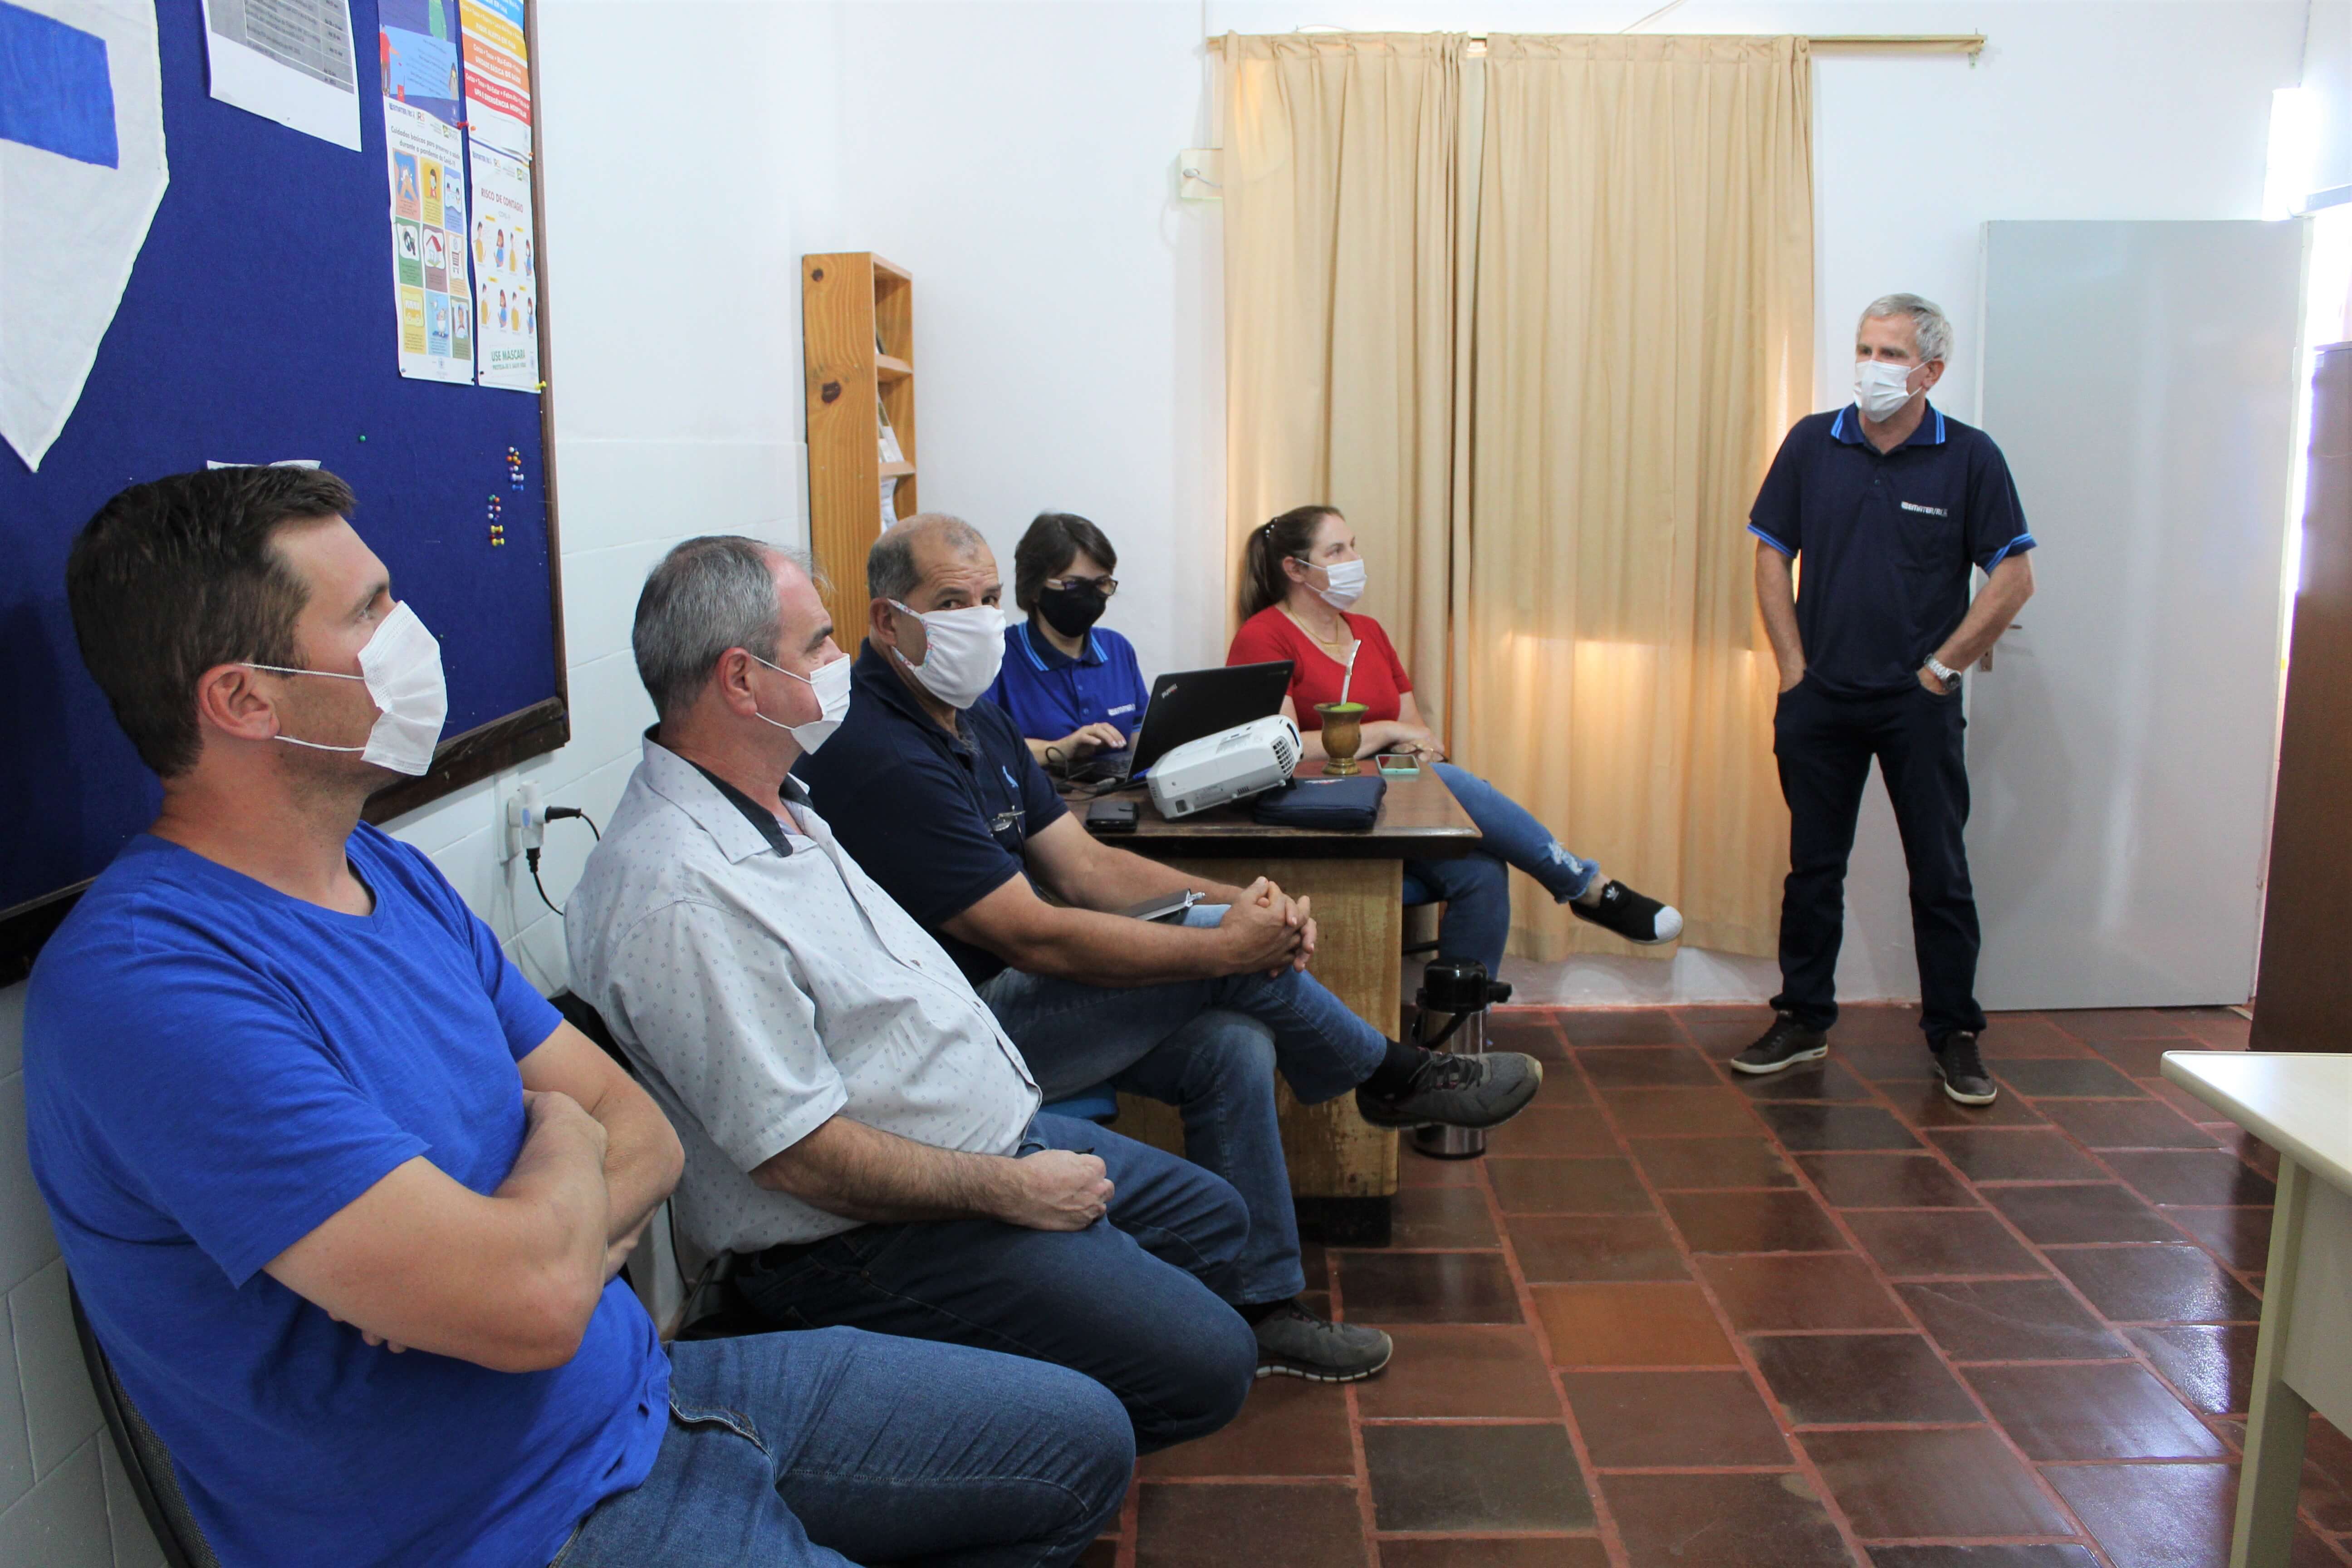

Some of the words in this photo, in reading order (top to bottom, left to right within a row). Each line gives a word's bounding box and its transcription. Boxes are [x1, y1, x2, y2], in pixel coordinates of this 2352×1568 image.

[391, 125, 410, 139] Cuidados
[481, 187, 495, 201] RISCO
[496, 193, 503, 204] DE
[491, 350, 501, 362] USE
